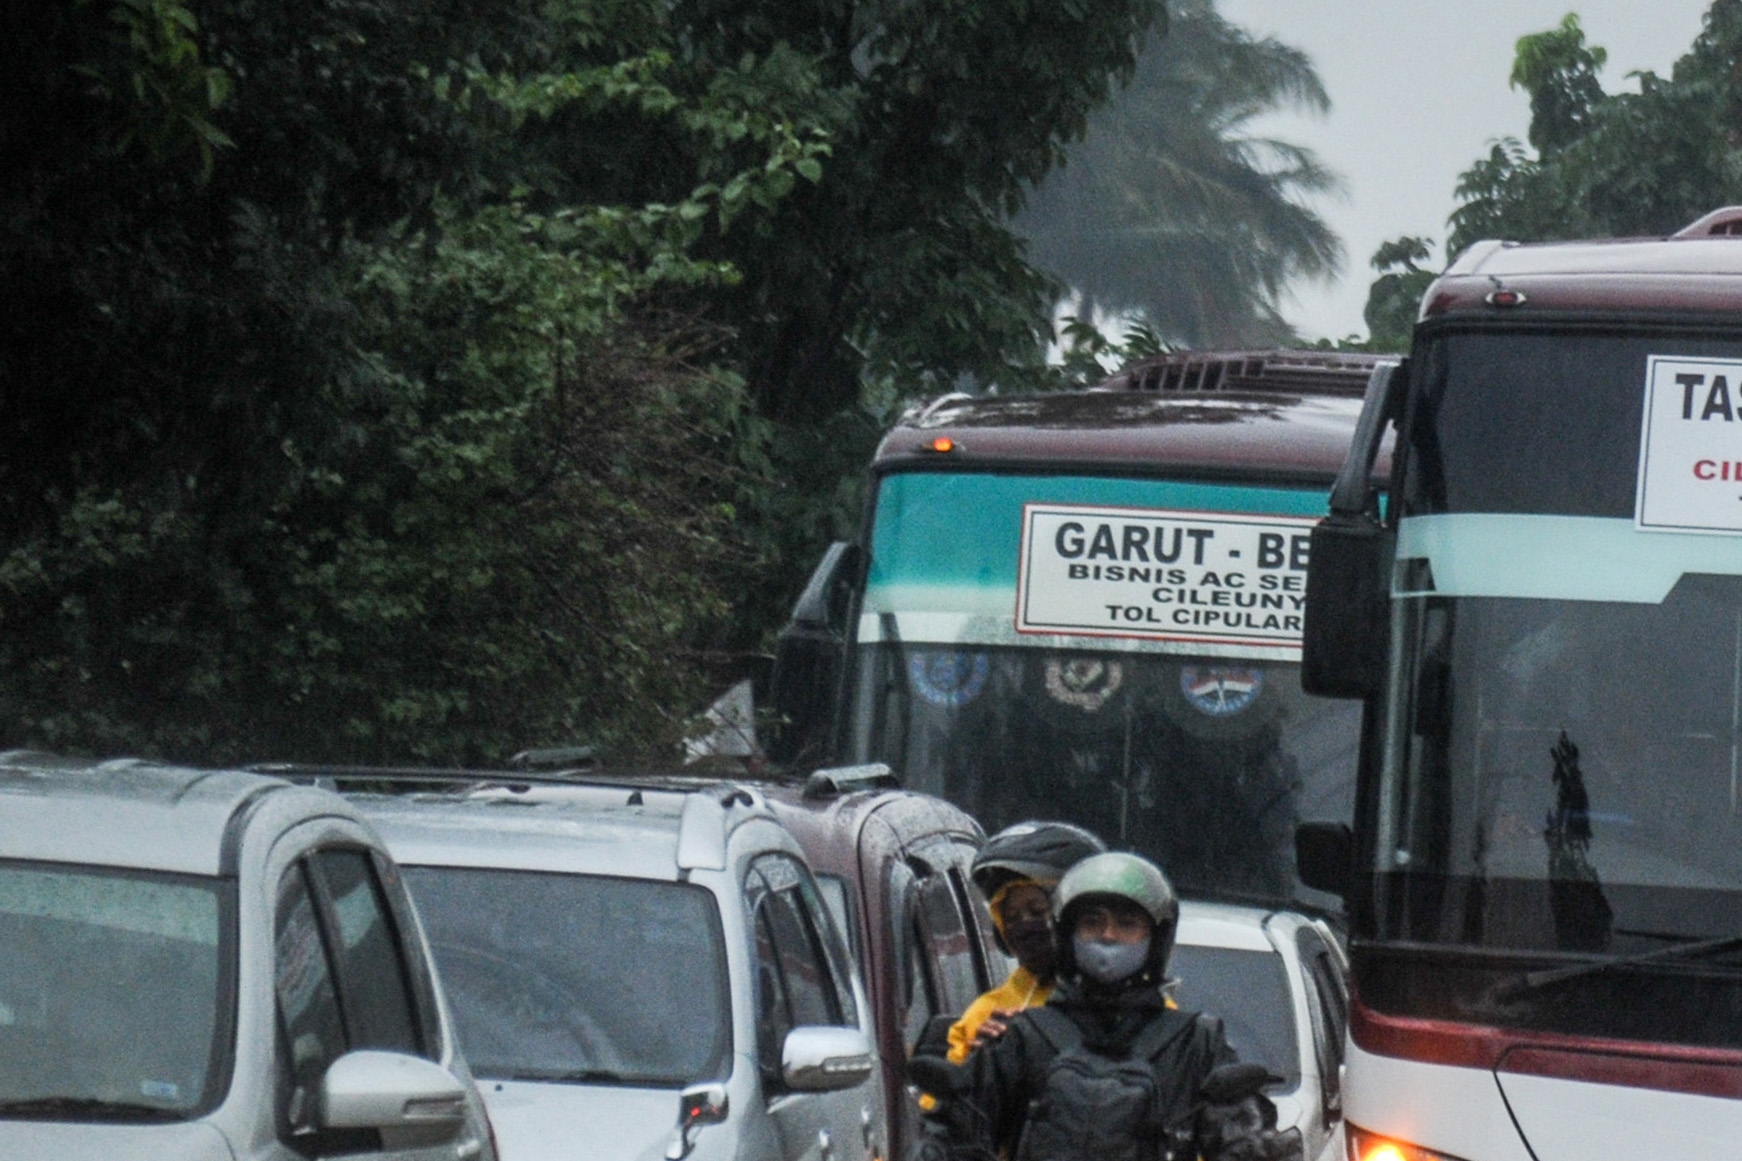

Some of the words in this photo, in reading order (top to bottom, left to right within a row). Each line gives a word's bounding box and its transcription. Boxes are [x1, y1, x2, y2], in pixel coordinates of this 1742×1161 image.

[1055, 522, 1214, 565] GARUT
[1069, 564, 1186, 584] BISNIS
[1201, 572, 1245, 588] AC
[1258, 575, 1302, 591] SE
[1106, 605, 1161, 623] TOL
[1172, 609, 1302, 631] CIPULAR
